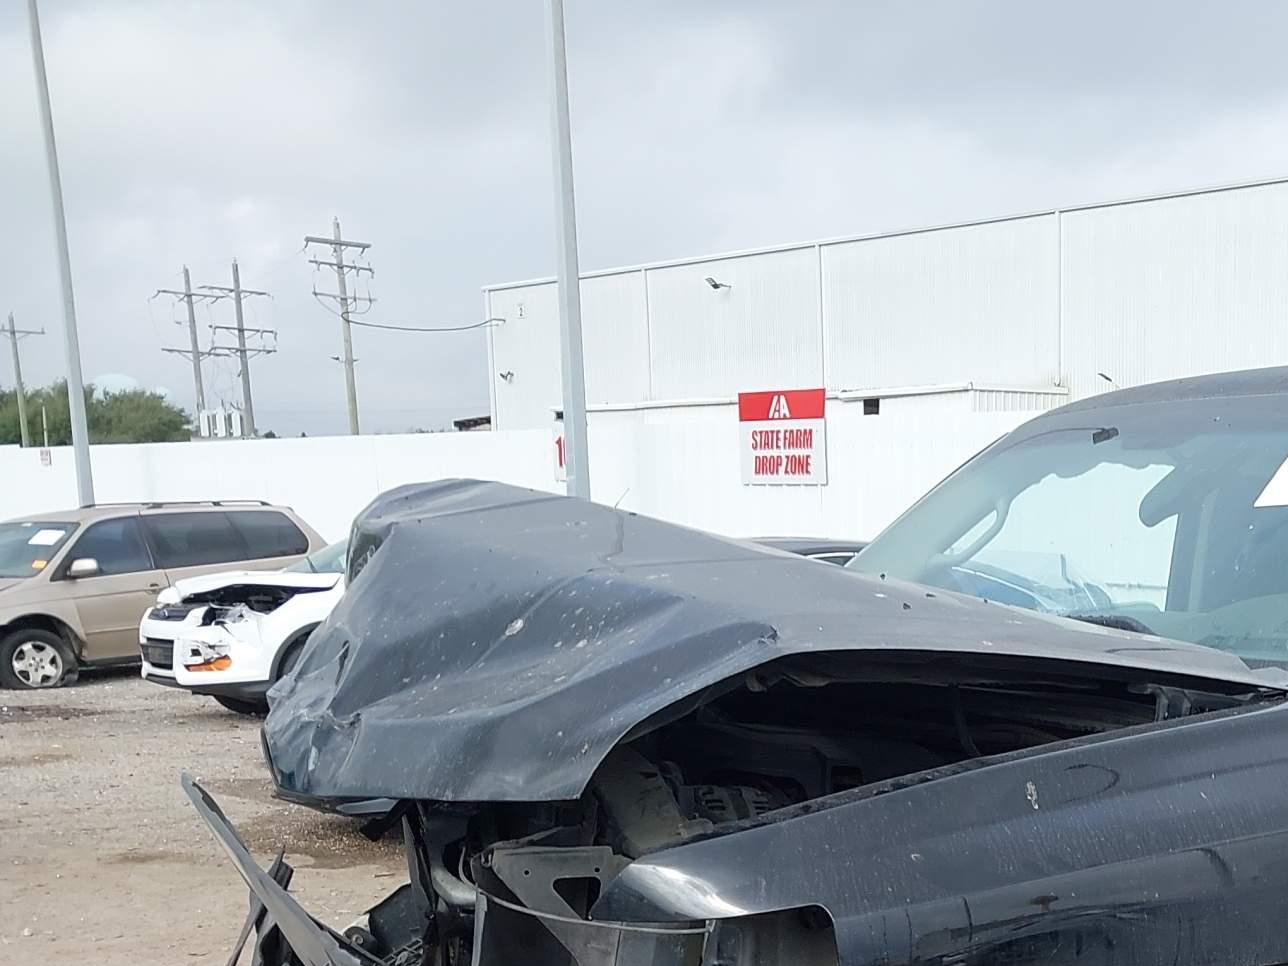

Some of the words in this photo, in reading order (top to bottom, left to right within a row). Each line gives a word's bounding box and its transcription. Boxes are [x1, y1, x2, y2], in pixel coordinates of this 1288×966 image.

[751, 430, 782, 451] STATE
[783, 428, 813, 450] FARM
[754, 455, 783, 476] DROP
[784, 454, 812, 476] ZONE
